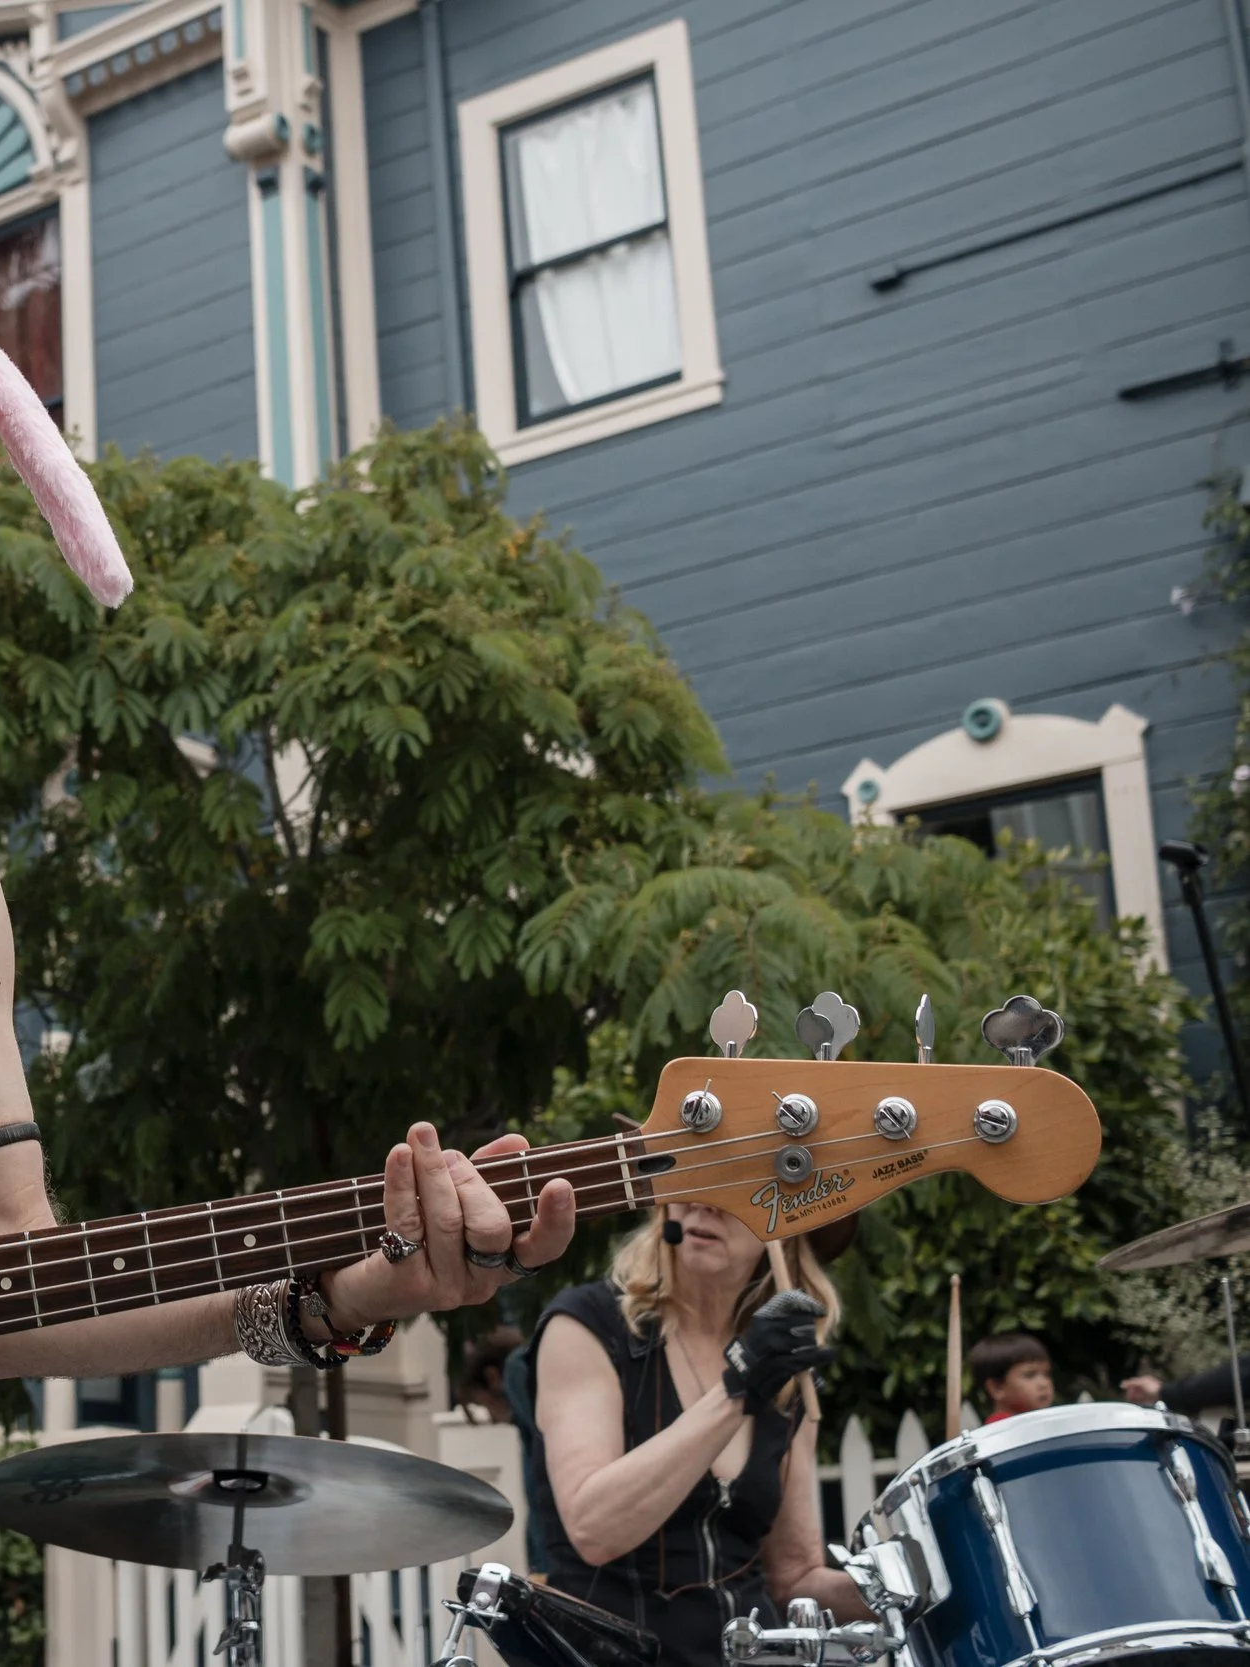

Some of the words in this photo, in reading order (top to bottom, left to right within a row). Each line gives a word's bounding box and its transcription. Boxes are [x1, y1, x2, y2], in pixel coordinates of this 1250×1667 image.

[872, 1163, 896, 1178] JAZZ
[897, 1153, 925, 1168] BASS
[750, 1171, 855, 1233] Fender
